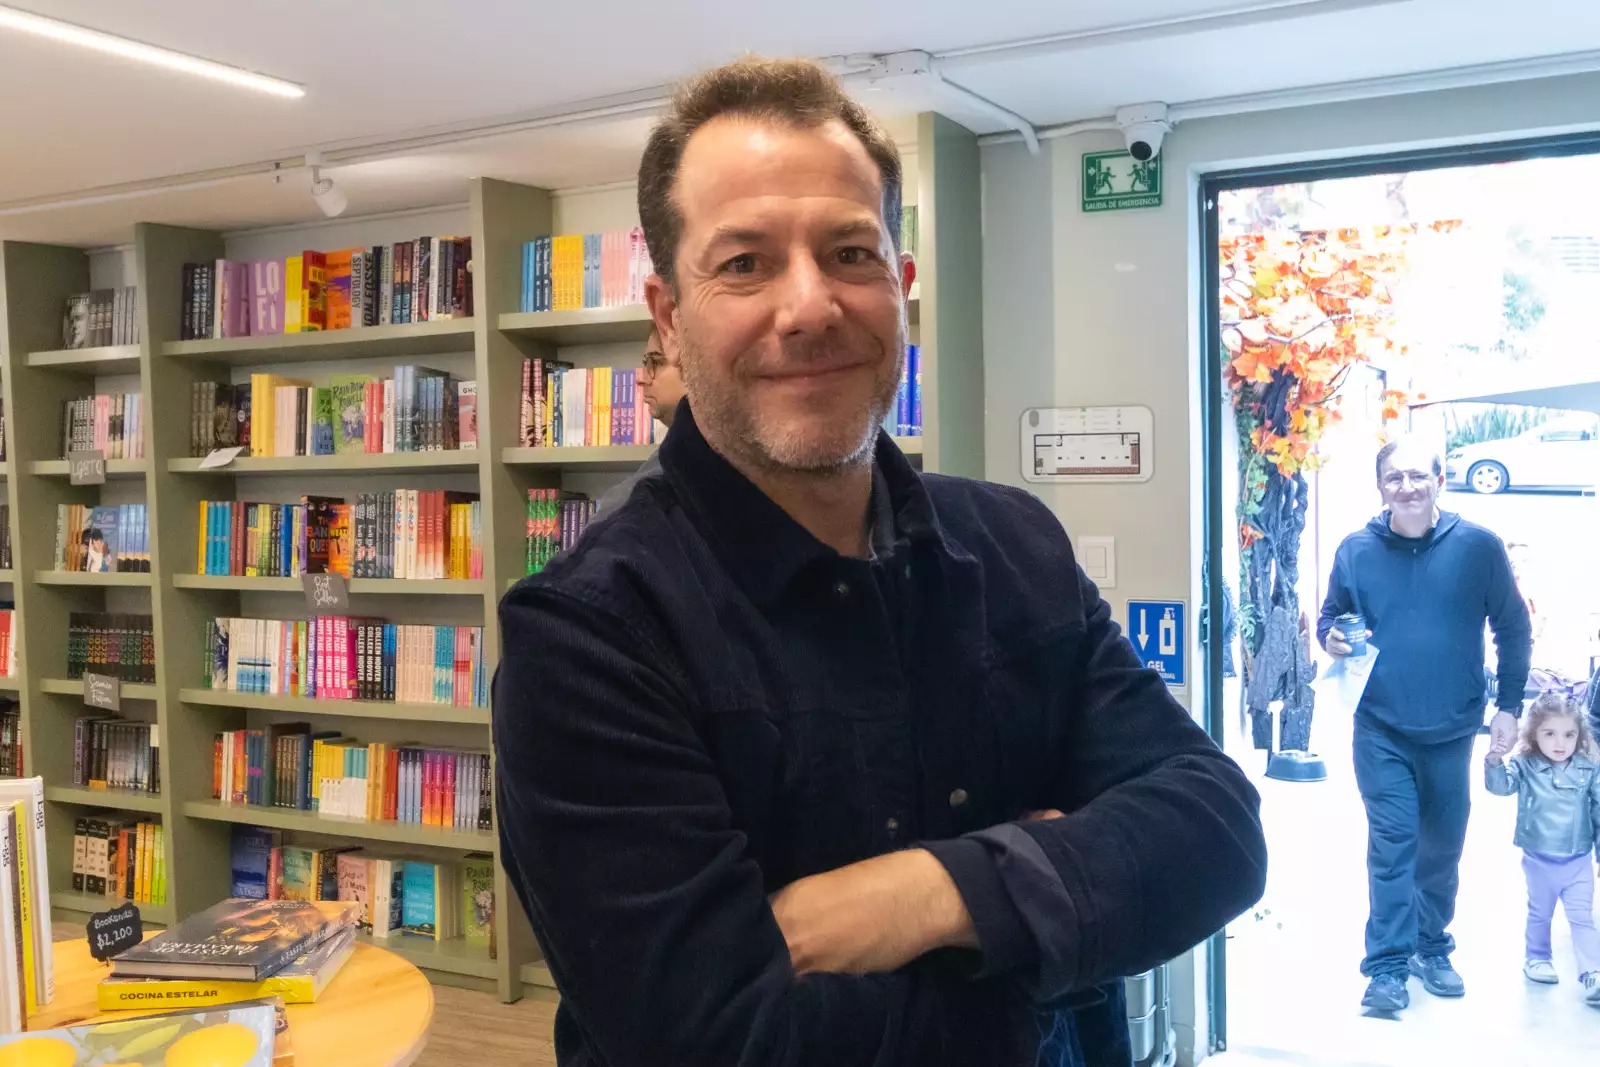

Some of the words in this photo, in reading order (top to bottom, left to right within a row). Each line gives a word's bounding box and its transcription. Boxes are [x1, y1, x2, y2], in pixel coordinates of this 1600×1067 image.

[1085, 202, 1107, 210] SALIDA
[1118, 198, 1159, 208] EMERGENCIA
[352, 256, 362, 309] SEPTOLOGY
[1148, 660, 1166, 672] GEL
[36, 800, 44, 830] Egg
[2, 836, 10, 868] Egg
[466, 866, 494, 880] RAINB
[20, 869, 28, 922] ESTELAR
[97, 926, 133, 950] $2,200
[119, 990, 164, 1000] COCINA
[166, 990, 218, 1000] ESTELAR
